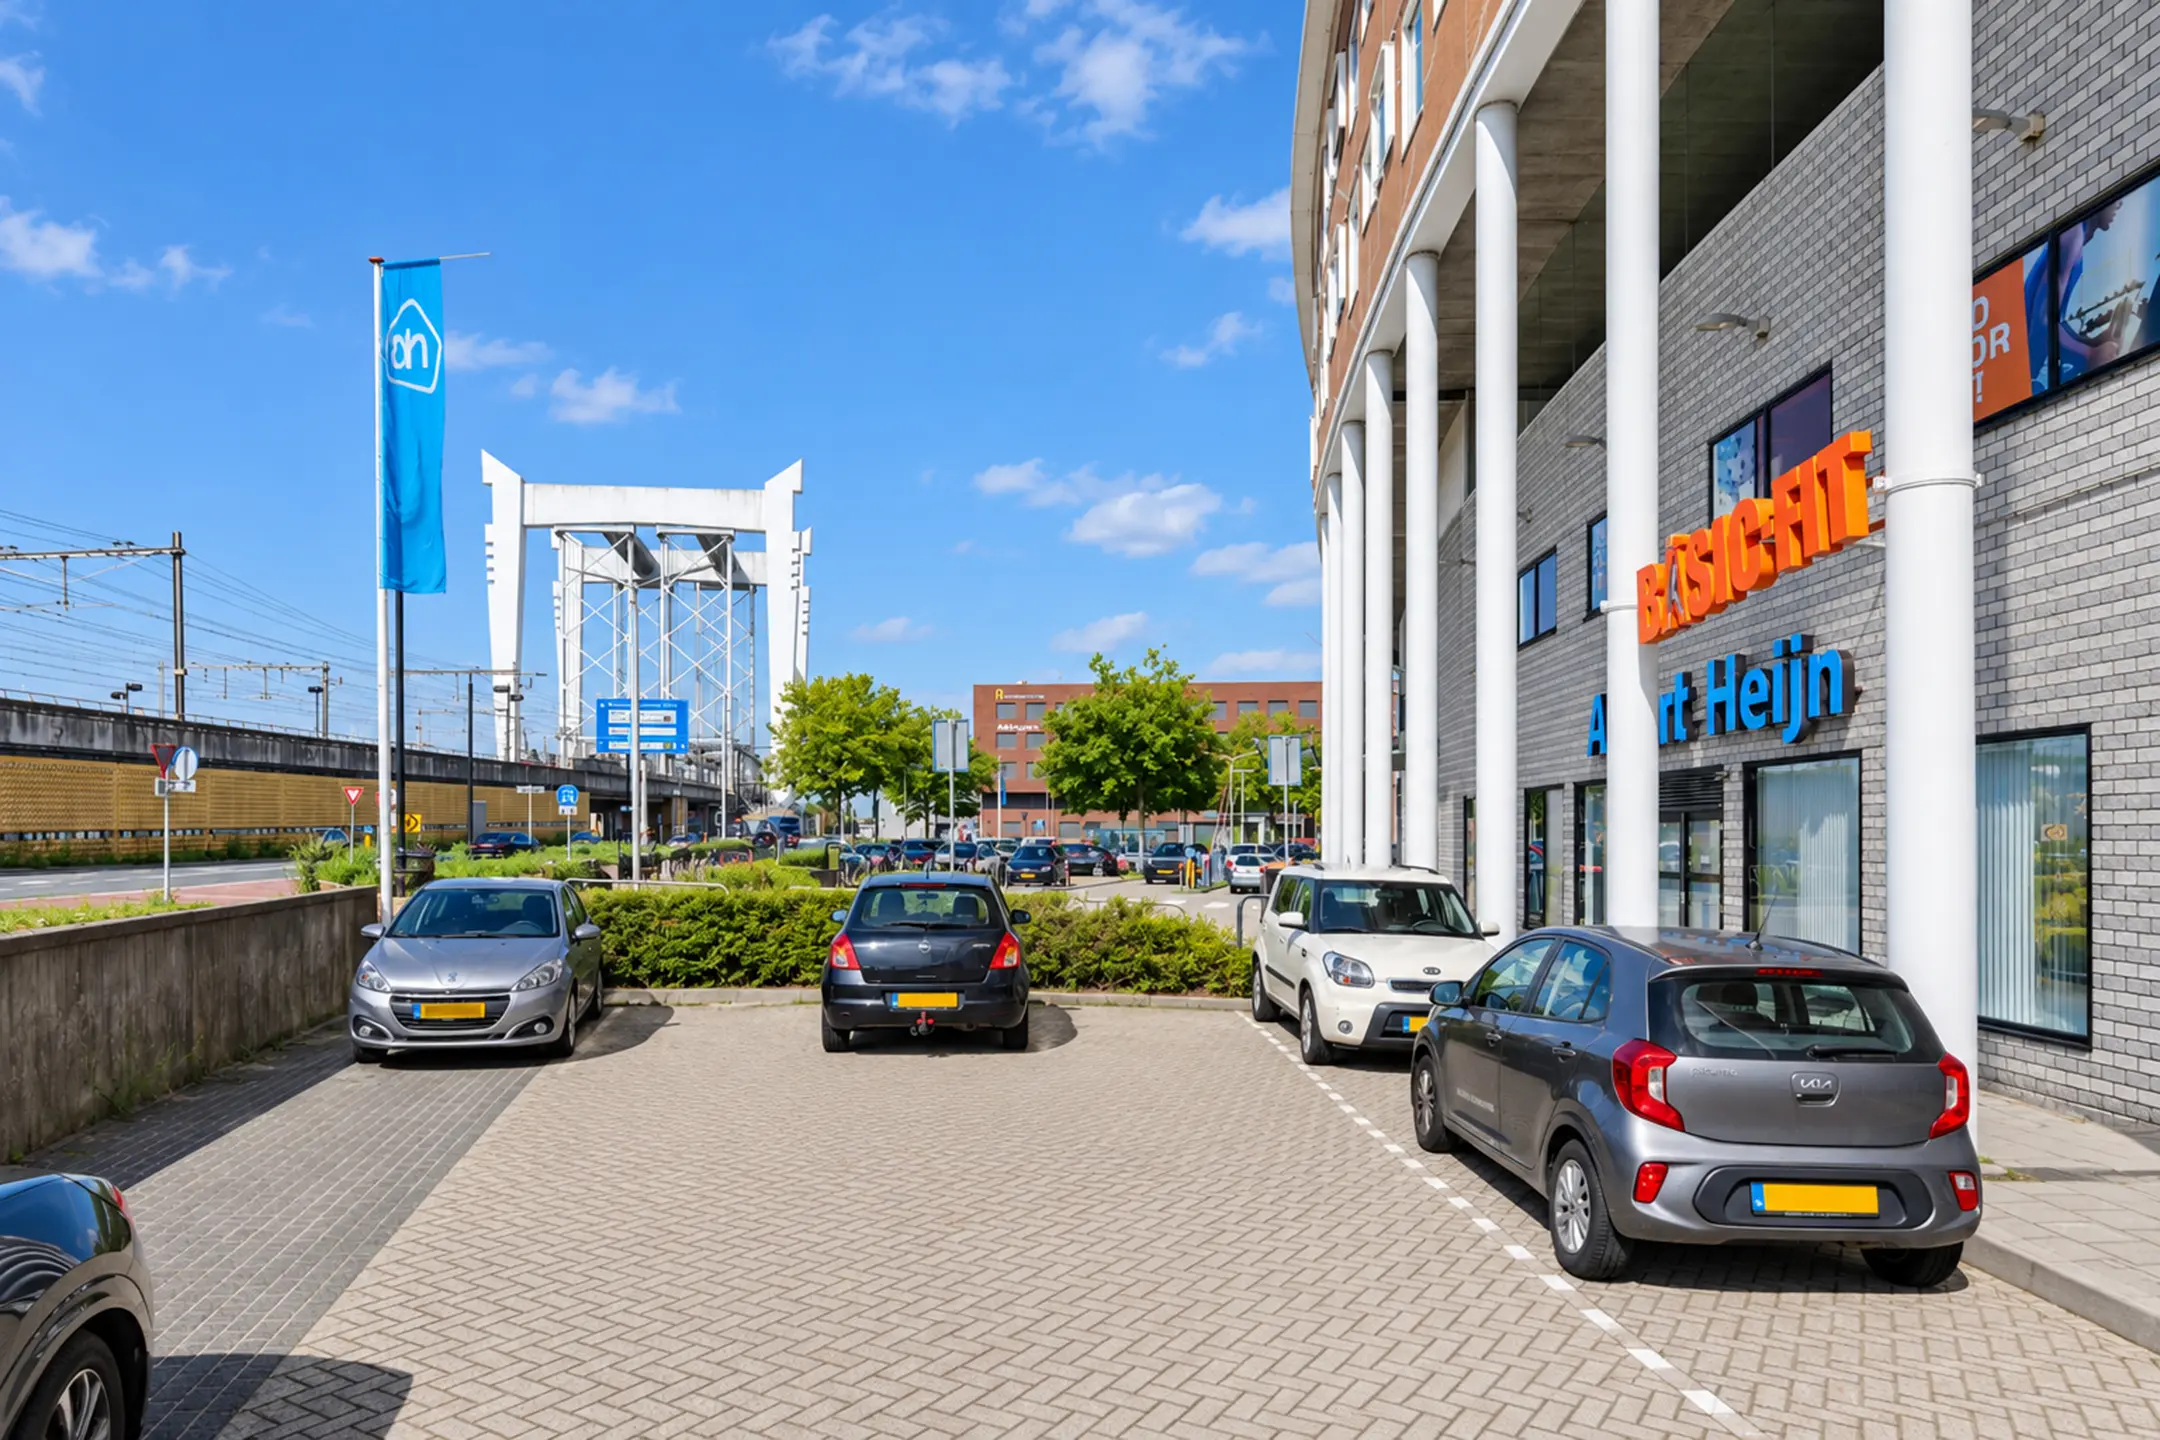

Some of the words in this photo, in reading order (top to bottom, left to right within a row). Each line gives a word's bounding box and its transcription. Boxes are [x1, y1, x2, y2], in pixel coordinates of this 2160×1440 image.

[1637, 430, 1872, 644] BASIC-FIT
[1587, 671, 1696, 758] Art
[1706, 633, 1855, 745] Heijn
[1800, 1078, 1833, 1089] KIA
